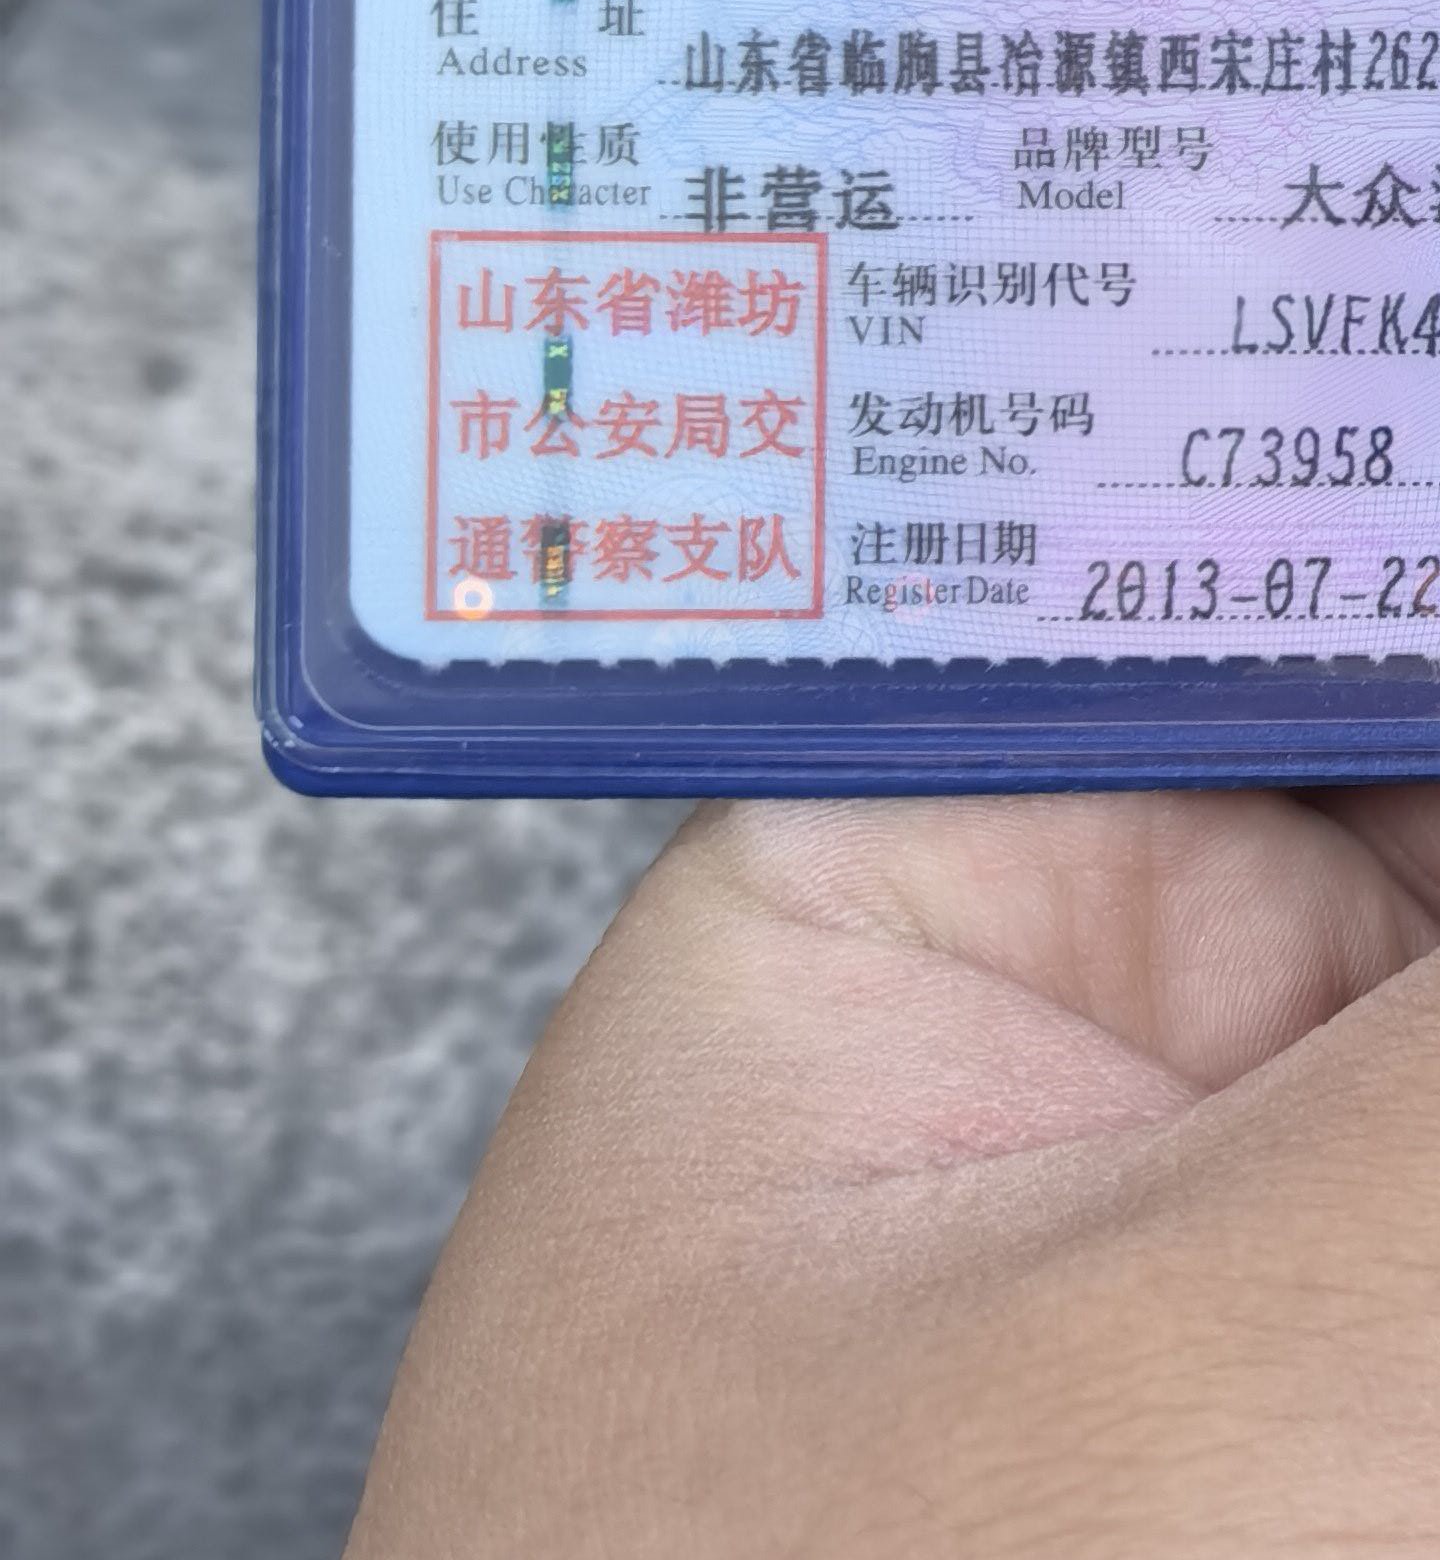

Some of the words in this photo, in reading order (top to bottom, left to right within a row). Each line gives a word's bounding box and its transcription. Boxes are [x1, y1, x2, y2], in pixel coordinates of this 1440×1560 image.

[437, 48, 588, 79] Address
[432, 121, 641, 168] 使用性质
[1014, 126, 1213, 172] 品牌型号
[437, 179, 491, 206] Use
[504, 175, 652, 207] Chacter
[686, 167, 900, 233] 非营运
[1018, 182, 1125, 211] Model
[456, 268, 806, 338] 山东省潍坊
[846, 261, 1137, 308] 车辆识别代号
[846, 316, 926, 346] VIN
[451, 391, 808, 460] 市公安局交
[848, 391, 1095, 438] 发动机号码
[853, 448, 967, 479] Engine
[979, 449, 1037, 477] No.
[1180, 425, 1395, 489] C73958
[449, 514, 801, 584] 通警察支队
[850, 522, 1037, 568] 注册日期
[846, 577, 963, 612] Register
[967, 579, 1030, 607] Date
